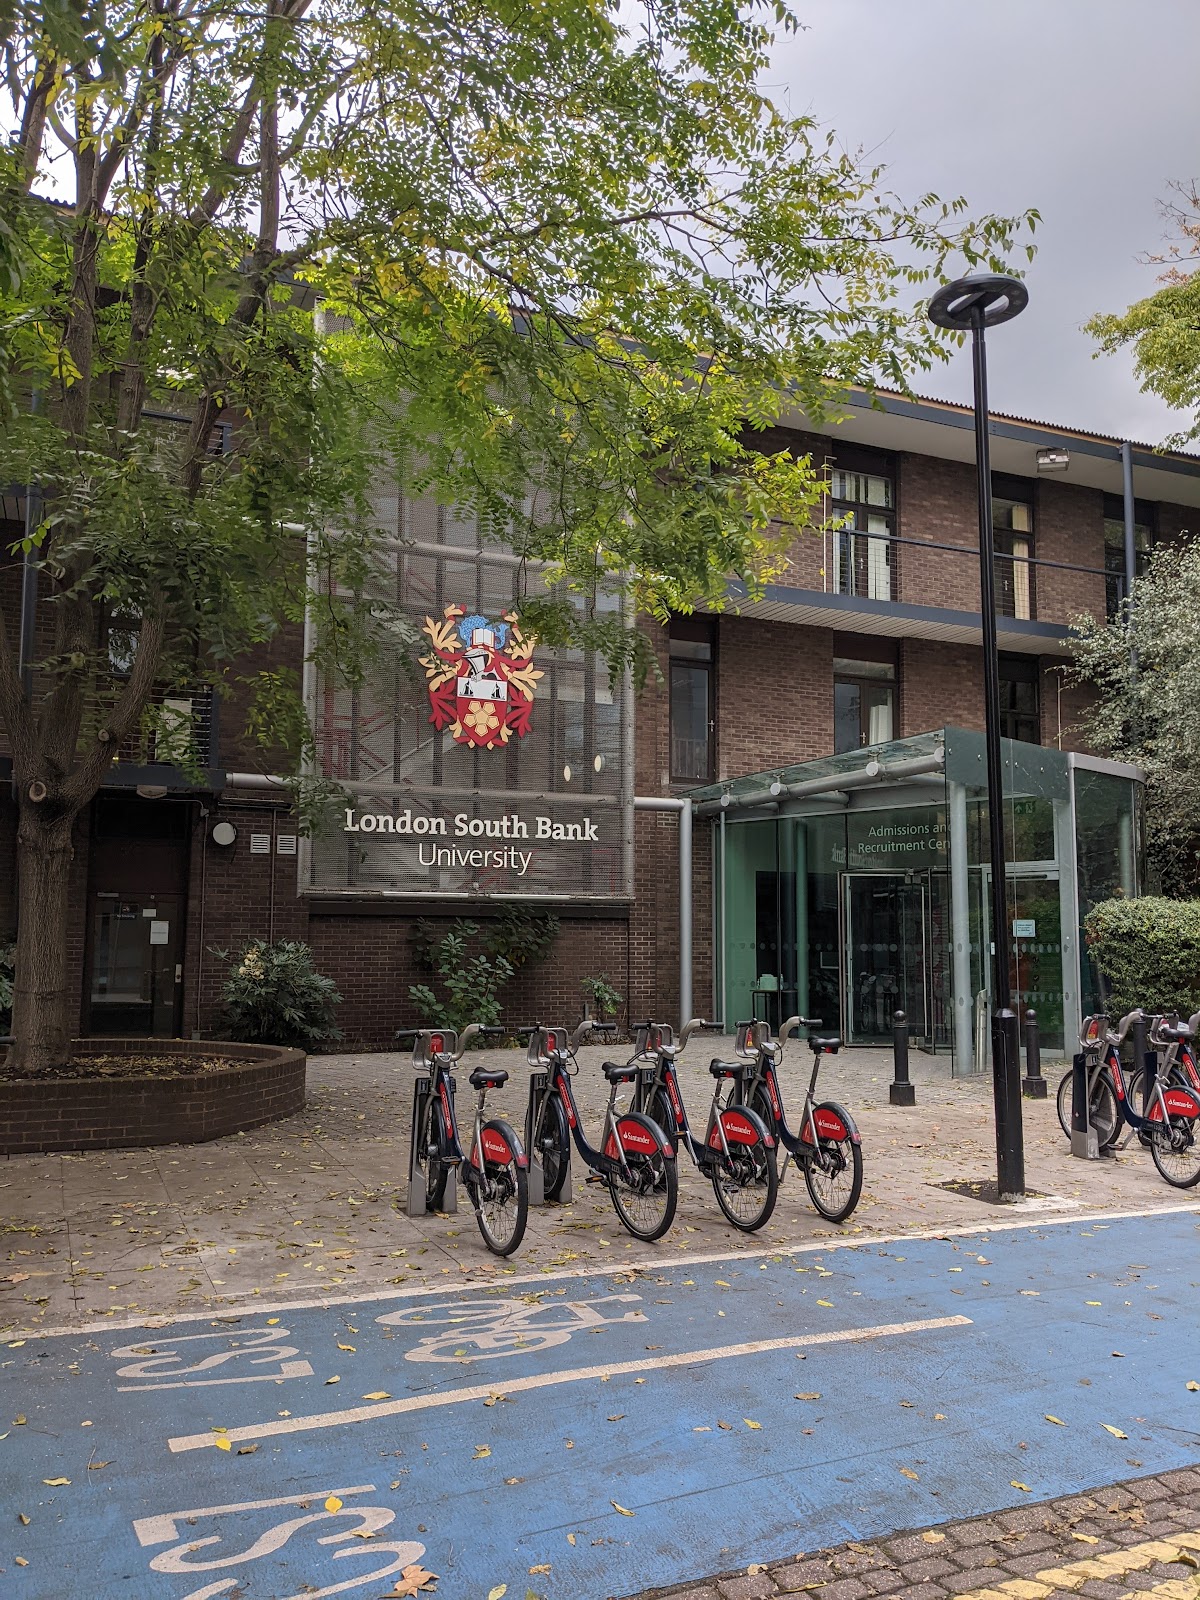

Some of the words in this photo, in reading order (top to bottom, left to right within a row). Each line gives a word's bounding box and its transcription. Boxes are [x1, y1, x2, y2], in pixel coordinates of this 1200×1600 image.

[344, 808, 447, 835] London
[454, 814, 529, 839] South
[535, 816, 599, 841] Bank
[868, 823, 930, 838] Admissions
[932, 823, 952, 834] an
[858, 840, 926, 854] Recruitment
[928, 838, 951, 850] Cen
[418, 843, 532, 876] University
